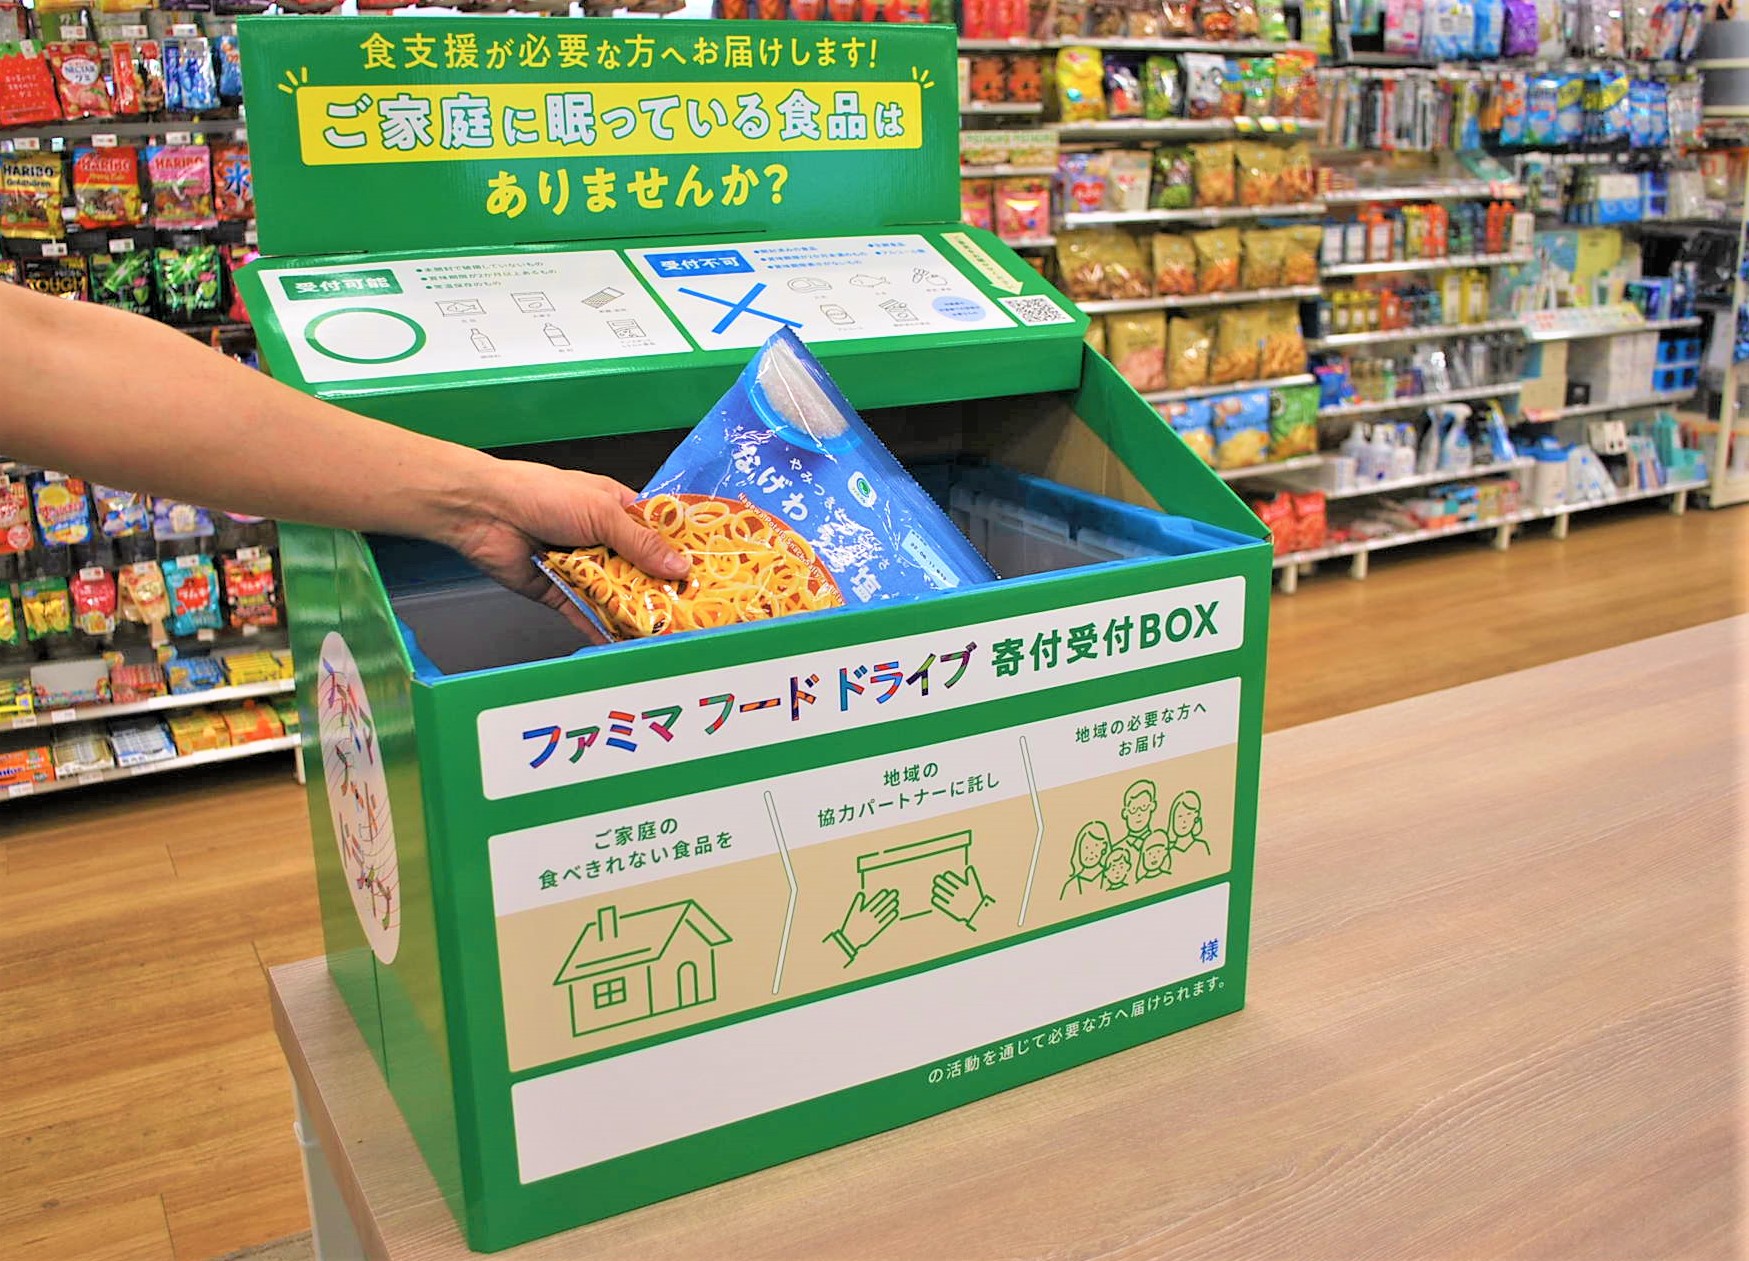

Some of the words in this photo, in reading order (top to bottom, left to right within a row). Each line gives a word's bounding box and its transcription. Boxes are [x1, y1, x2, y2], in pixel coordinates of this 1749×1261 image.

[360, 32, 878, 69] 食支援が必要な方へお届けします!
[322, 89, 905, 151] ご家庭に眠っている食品は
[3, 163, 54, 177] HARIBO
[81, 157, 131, 171] HARIBO
[154, 155, 203, 169] HARIBO
[486, 163, 789, 219] ありませんか?
[660, 256, 740, 271] 受付不可
[294, 276, 391, 293] 受付可能
[522, 704, 683, 769] ファミマ
[699, 673, 820, 736] フード
[838, 640, 978, 712] ドライブ
[990, 600, 1220, 679] 寄付受付BOX
[1075, 701, 1208, 744] 地域の必要な方へ
[1118, 732, 1167, 757] お届け
[883, 761, 939, 788] 地域の
[817, 771, 1001, 828] 協力パートナーに託し
[594, 817, 679, 851] ご家庭の
[538, 830, 734, 891] 食べきれない食品を
[1199, 937, 1220, 964] 様
[928, 975, 1226, 1085] の活動を通じて必要な方へ届けられます。
